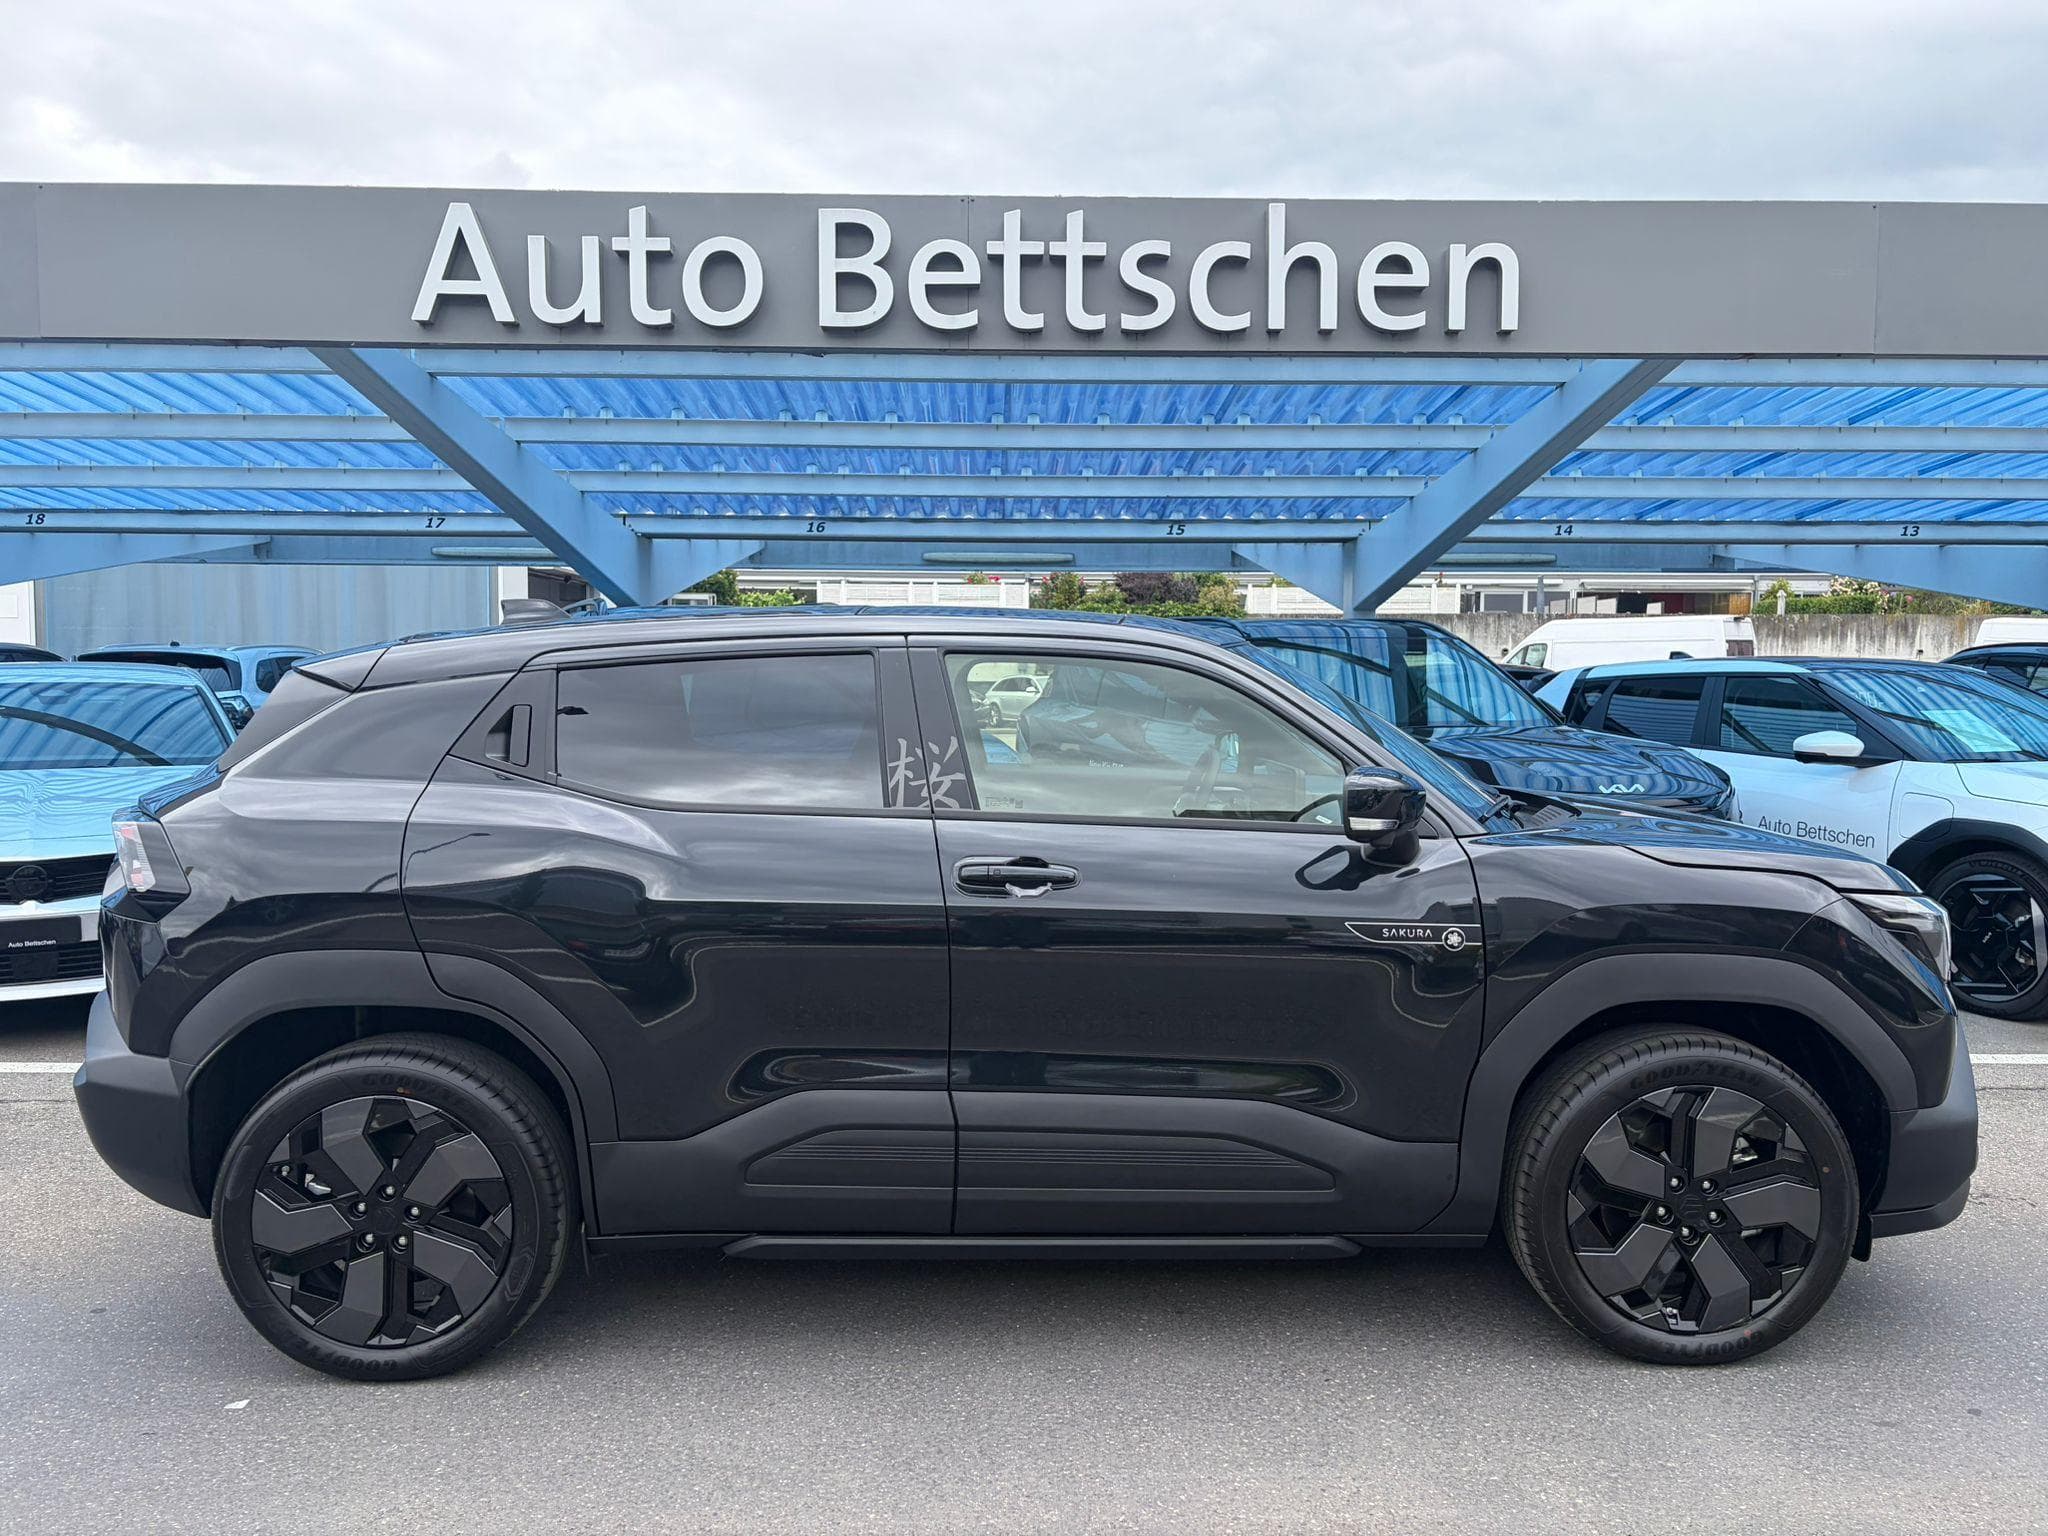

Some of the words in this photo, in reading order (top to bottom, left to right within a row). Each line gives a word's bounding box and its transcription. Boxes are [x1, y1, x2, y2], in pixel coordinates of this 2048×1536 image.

[411, 202, 764, 327] Auto
[819, 202, 1520, 332] Bettschen
[25, 513, 46, 525] 18
[425, 517, 446, 529] 17
[806, 521, 826, 533] 16
[1166, 524, 1186, 536] 15
[1554, 525, 1574, 536] 14
[1900, 525, 1920, 537] 13
[1758, 815, 1792, 836] Auto
[1796, 821, 1875, 849] Bettschen
[1382, 928, 1433, 938] SAKURA
